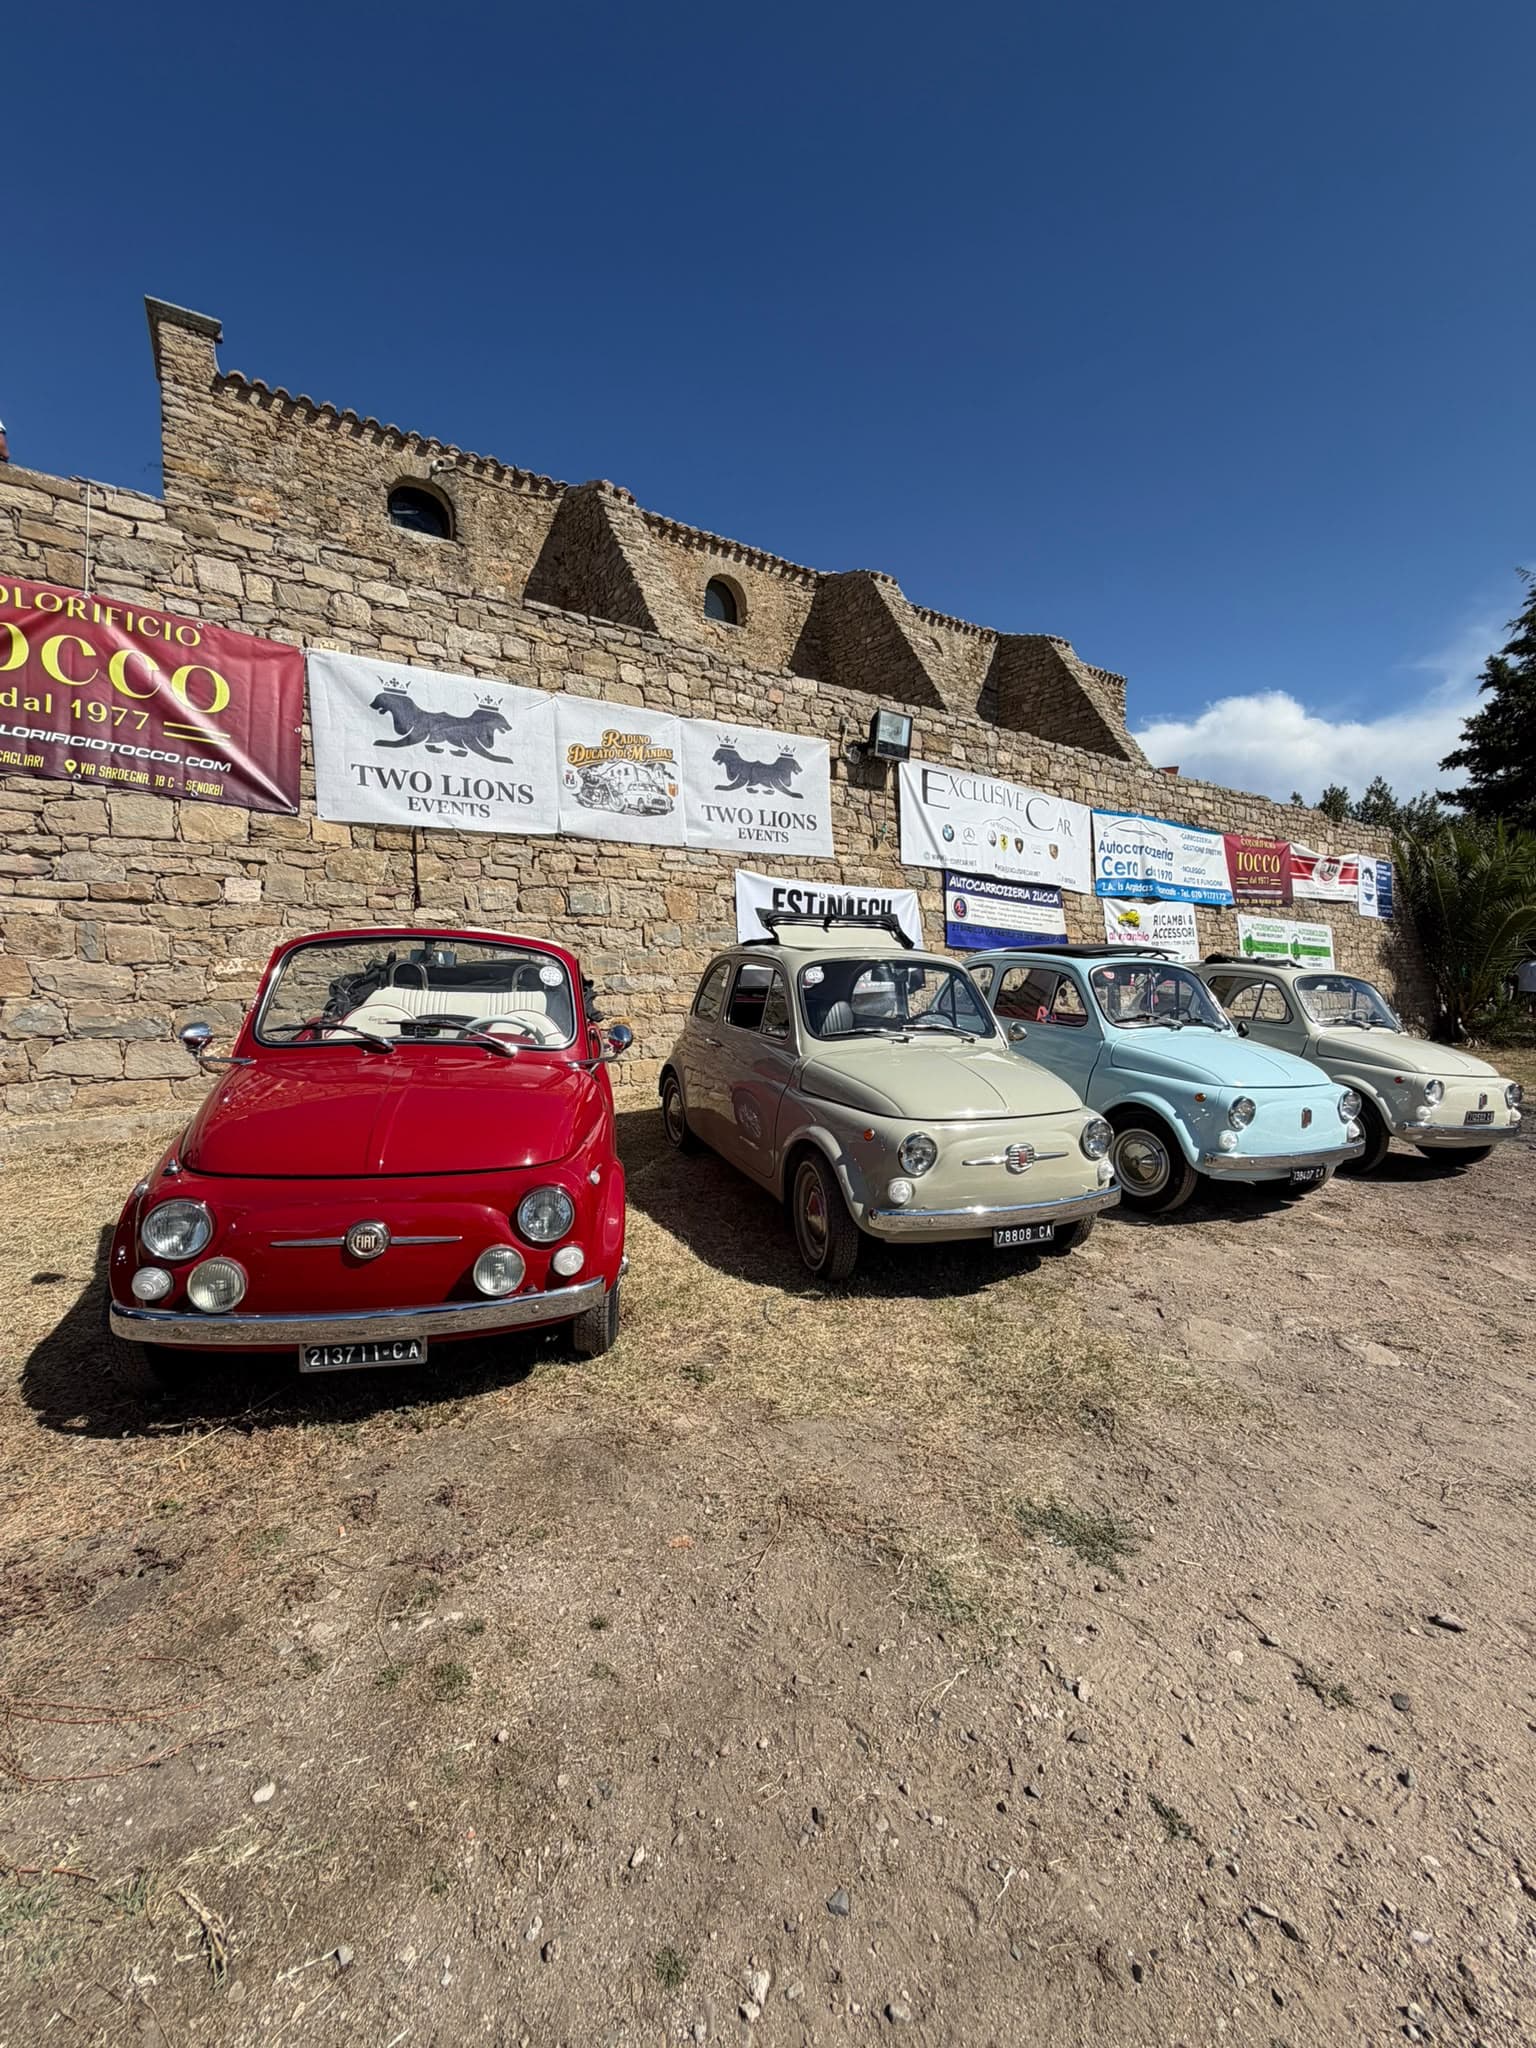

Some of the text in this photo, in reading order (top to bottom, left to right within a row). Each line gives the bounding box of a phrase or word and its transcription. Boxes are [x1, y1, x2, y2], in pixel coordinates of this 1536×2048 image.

[0, 687, 150, 731] dal 1977
[80, 762, 96, 776] VIA
[155, 774, 165, 788] 18
[167, 776, 175, 789] C
[350, 763, 535, 805] TWO LIONS
[407, 795, 491, 819] EVENTS
[921, 768, 1073, 837] EXCLUSIVE CAR
[701, 803, 818, 831] TWO LIONS
[738, 827, 790, 844] EVENTS
[1235, 850, 1281, 874] TOCCO
[948, 875, 1060, 905] AUTOCARROZZERIA ZUCCA
[1152, 914, 1187, 926] RICAMBI
[1152, 927, 1195, 940] ACCESSORI
[355, 1234, 377, 1249] FIAT
[1038, 1224, 1052, 1239] CA
